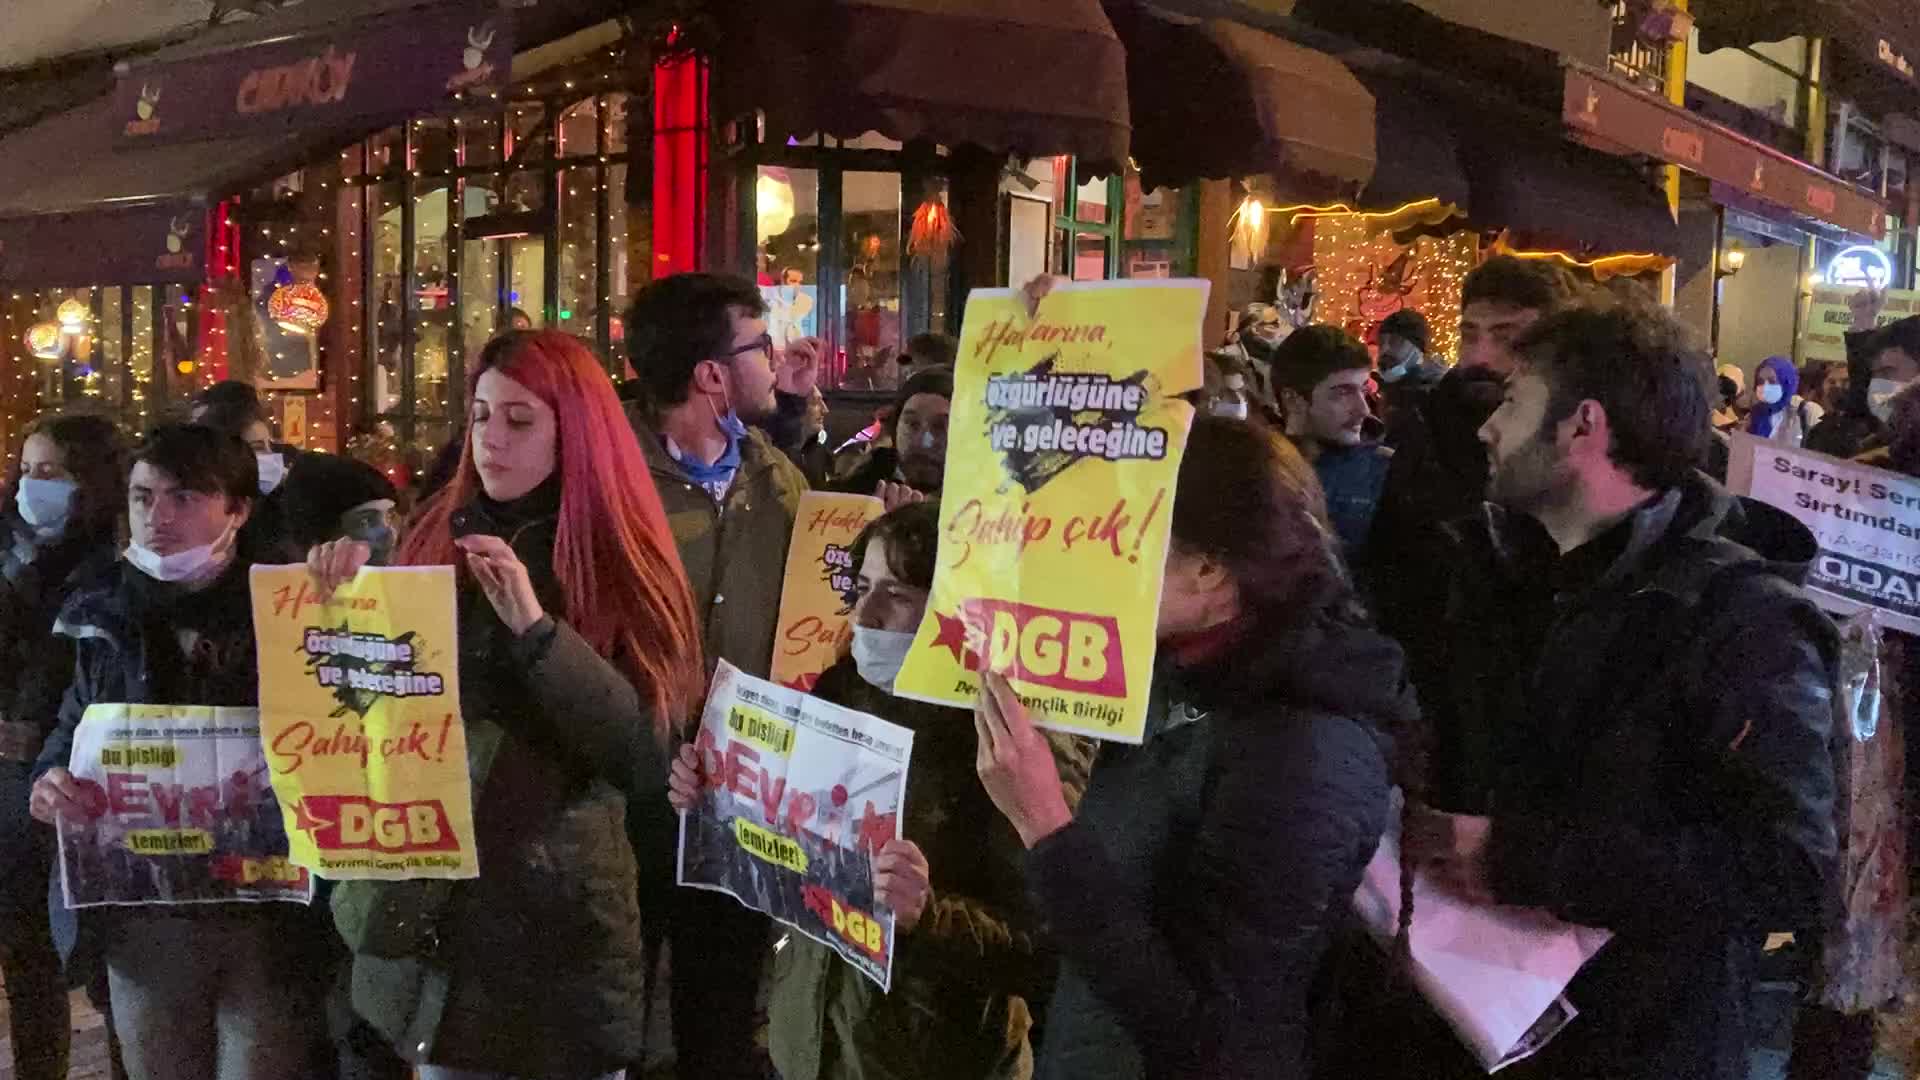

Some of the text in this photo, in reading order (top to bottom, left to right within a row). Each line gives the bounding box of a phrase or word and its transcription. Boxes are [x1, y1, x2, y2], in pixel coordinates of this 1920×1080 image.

[991, 418, 1165, 458] ve geleceğine
[1773, 456, 1861, 495] Saray!
[831, 574, 853, 590] ve
[989, 609, 1110, 683] DGB
[318, 665, 343, 685] ve
[340, 803, 441, 848] DGB
[831, 899, 881, 953] DGB
